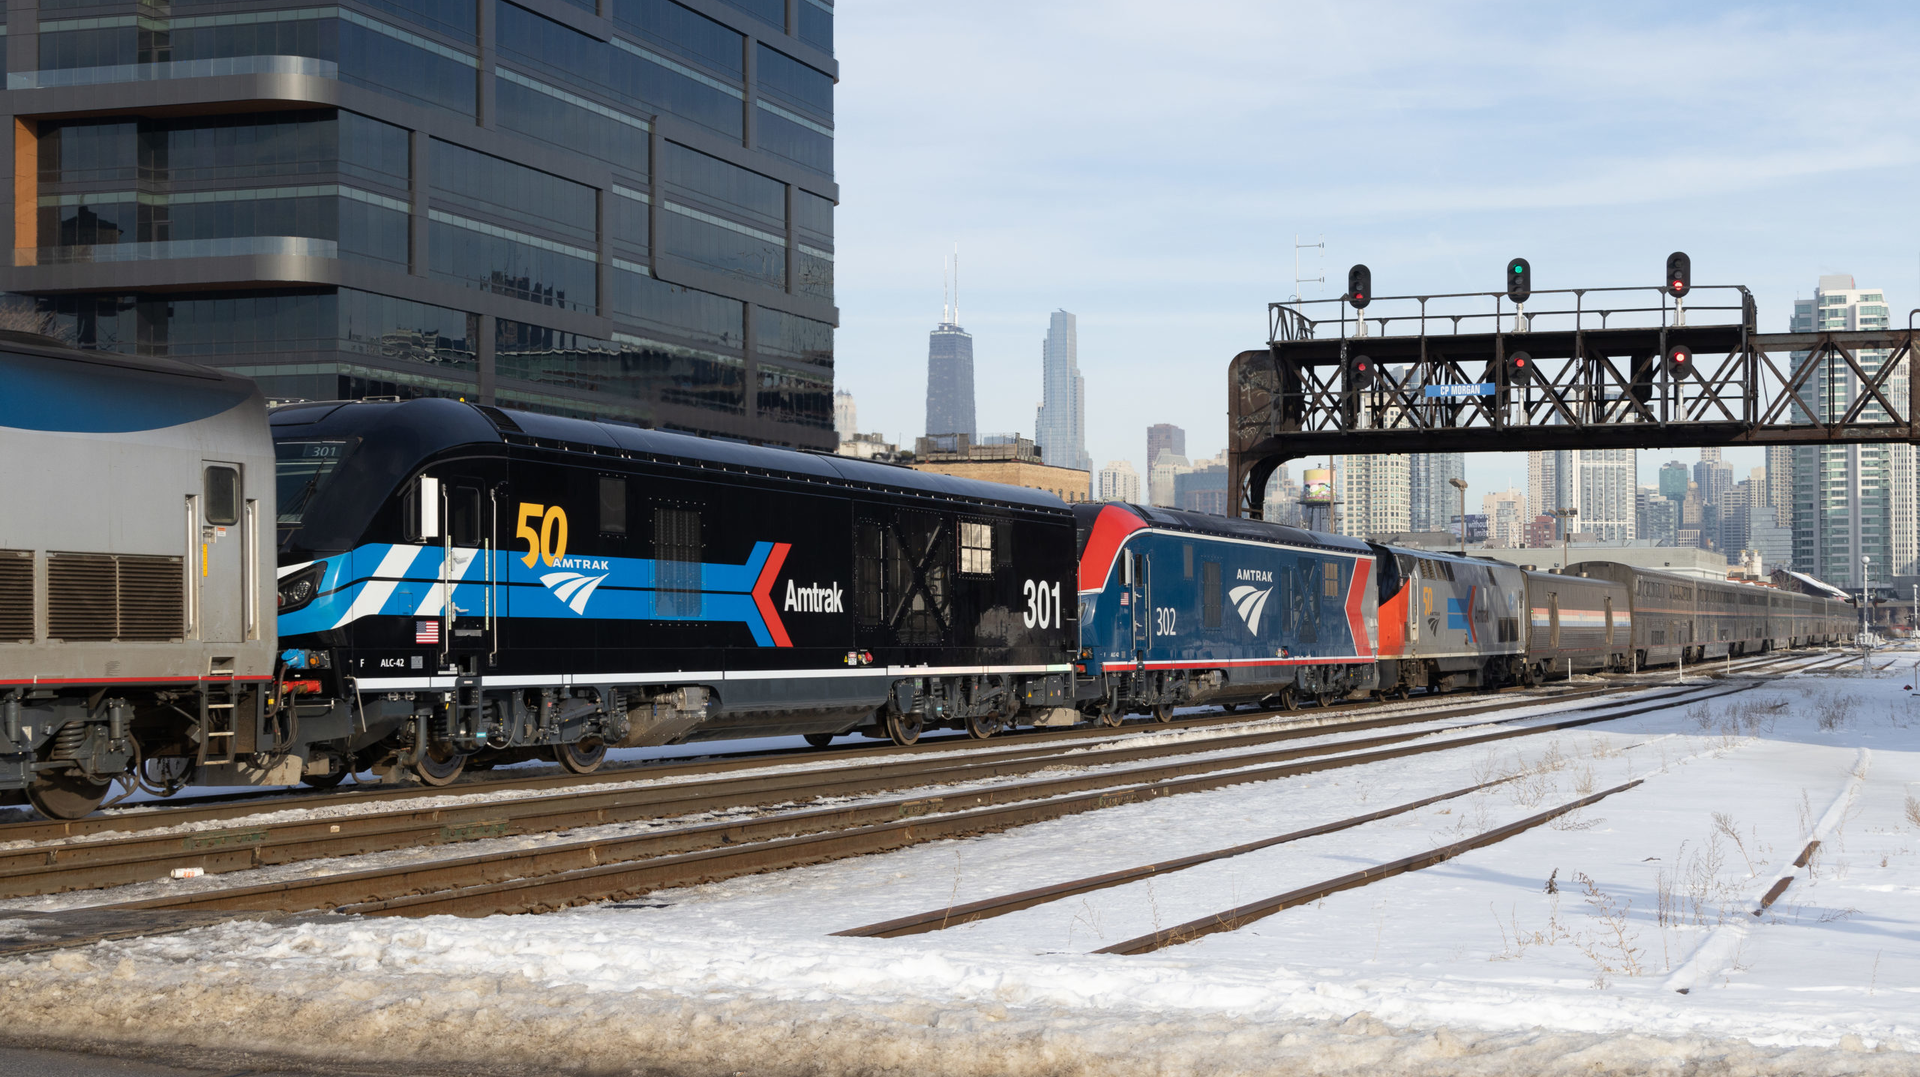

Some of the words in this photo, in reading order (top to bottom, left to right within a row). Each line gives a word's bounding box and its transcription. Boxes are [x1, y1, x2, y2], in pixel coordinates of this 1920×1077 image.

[1440, 386, 1449, 395] CP
[1451, 384, 1480, 395] MORGAN
[312, 446, 336, 457] 301
[516, 502, 568, 569] 50
[552, 558, 609, 570] AMTRAK
[1236, 568, 1273, 583] AMTRAK
[784, 579, 844, 613] Amtrak
[1023, 579, 1061, 629] 301
[1423, 586, 1433, 616] 50
[1156, 607, 1177, 636] 302
[360, 659, 365, 667] F
[380, 658, 405, 668] ALC-42
